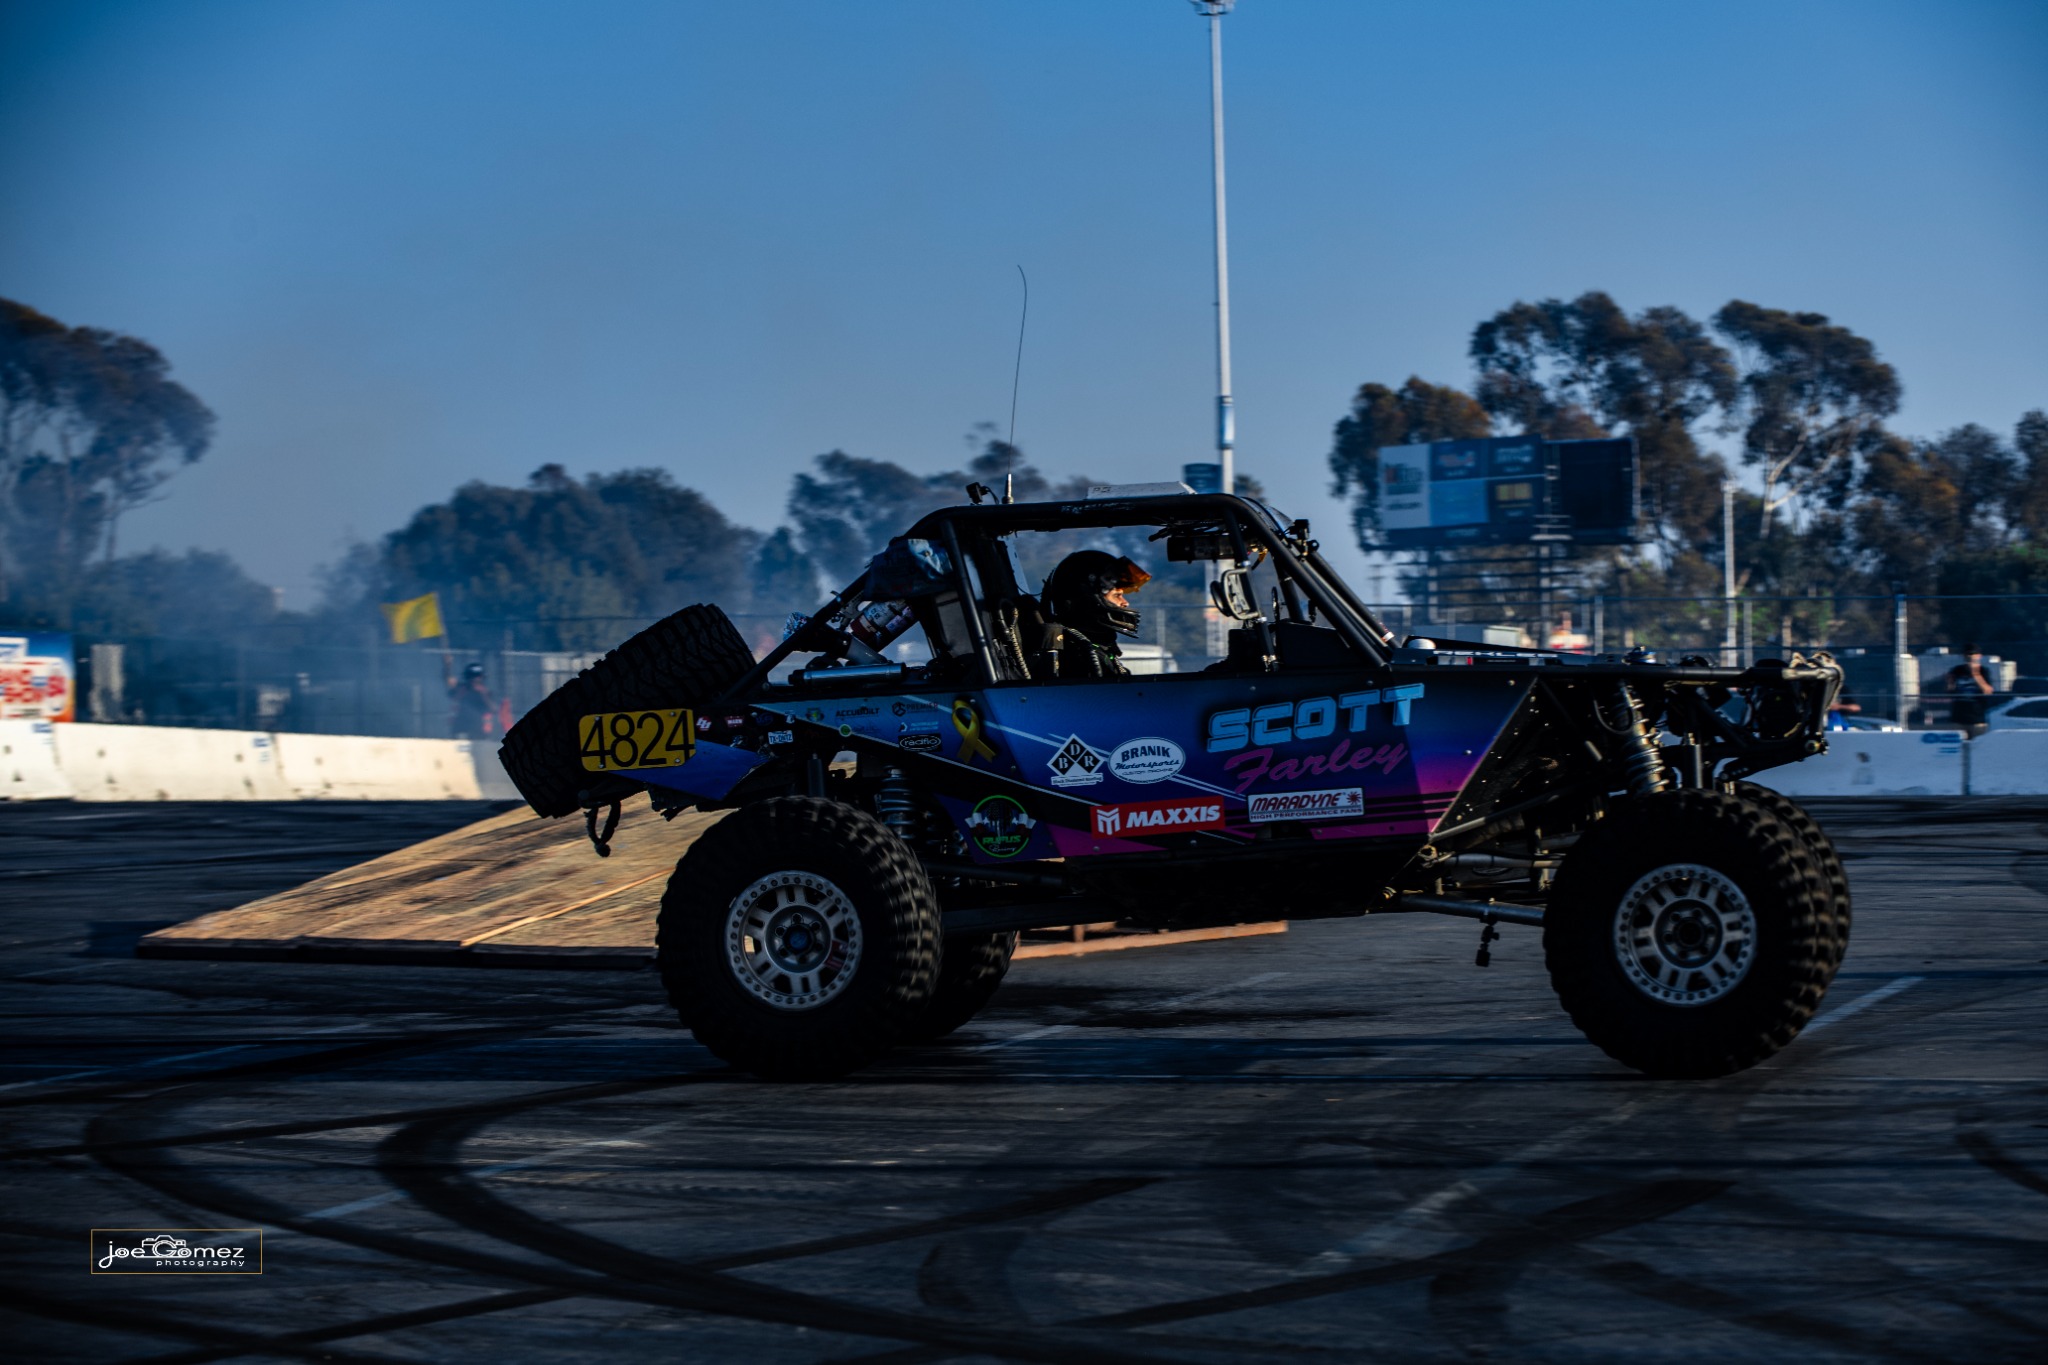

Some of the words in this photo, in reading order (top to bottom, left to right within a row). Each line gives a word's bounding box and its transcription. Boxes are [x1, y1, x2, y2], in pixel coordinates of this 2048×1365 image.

[1206, 682, 1425, 753] SCOTT
[580, 710, 695, 768] 4824
[1121, 745, 1171, 762] BRANIK
[1114, 759, 1180, 771] Motorsports
[1223, 738, 1408, 794] Farley
[1251, 793, 1341, 812] MARADYNE
[1126, 804, 1221, 828] MAXXIS
[1273, 809, 1339, 818] PERFORMANCE
